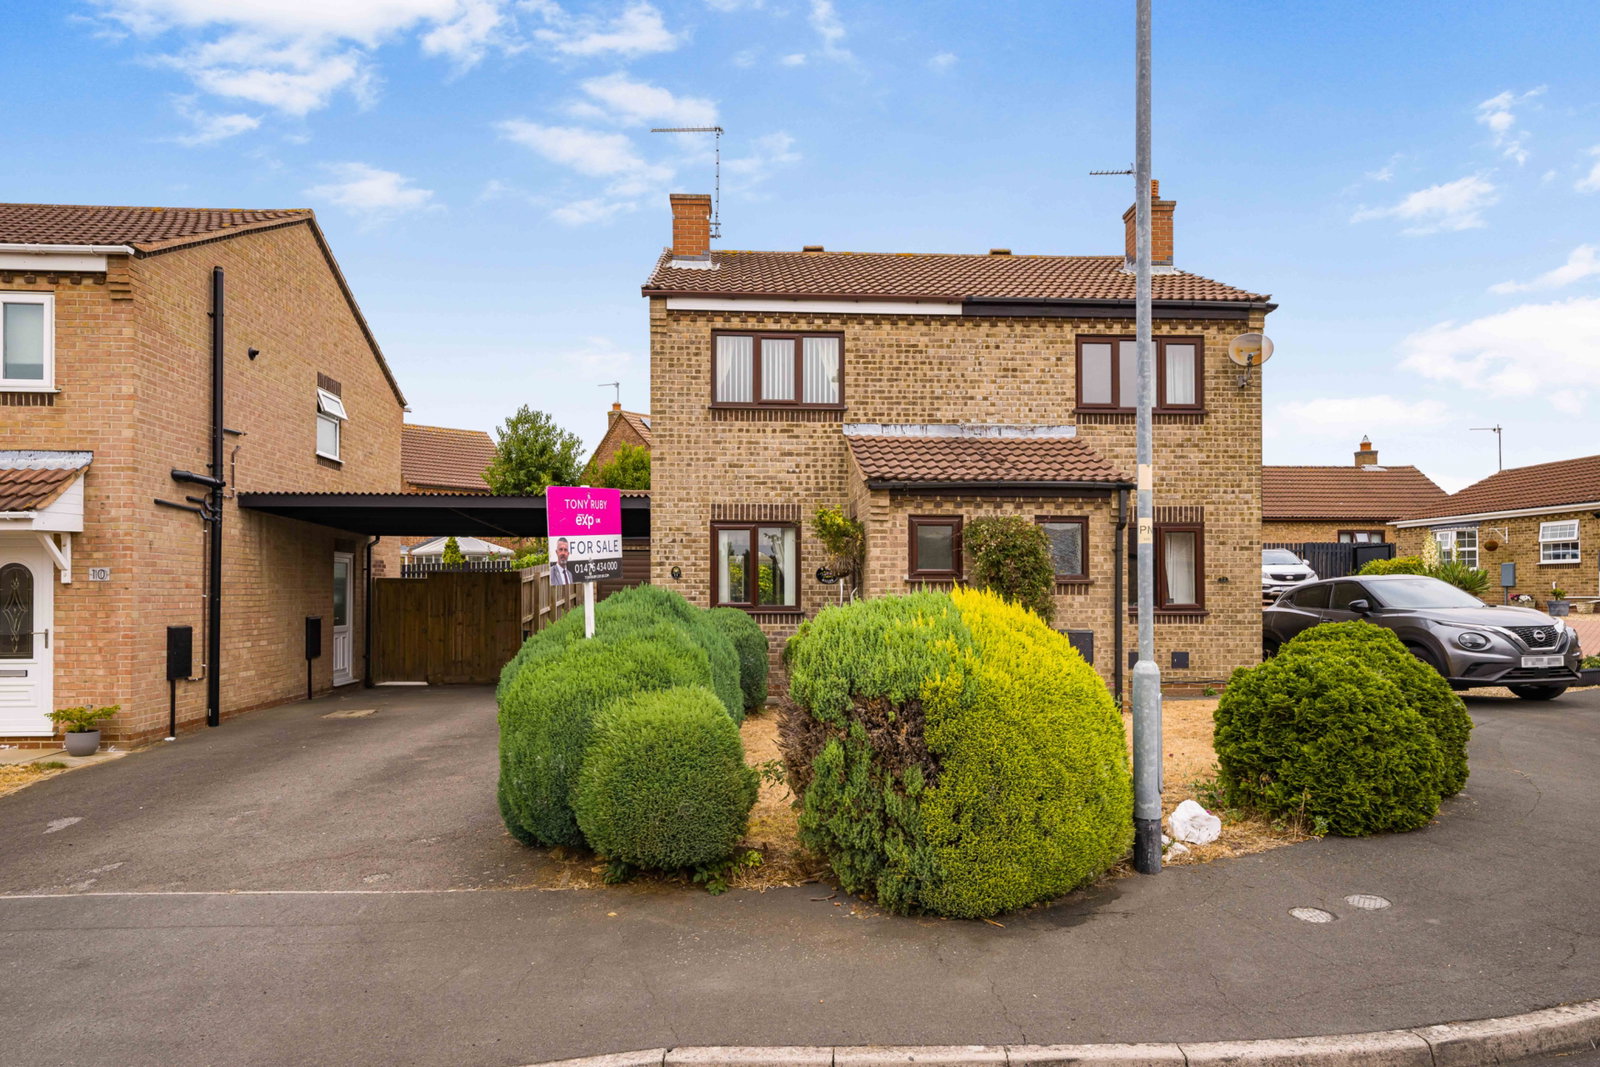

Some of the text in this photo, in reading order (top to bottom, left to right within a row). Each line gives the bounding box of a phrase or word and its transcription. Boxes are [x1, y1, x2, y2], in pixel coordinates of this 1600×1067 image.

[564, 499, 607, 509] TONY RUBY
[576, 514, 593, 529] exp
[570, 540, 619, 554] FOR SALE
[92, 569, 105, 580] 10
